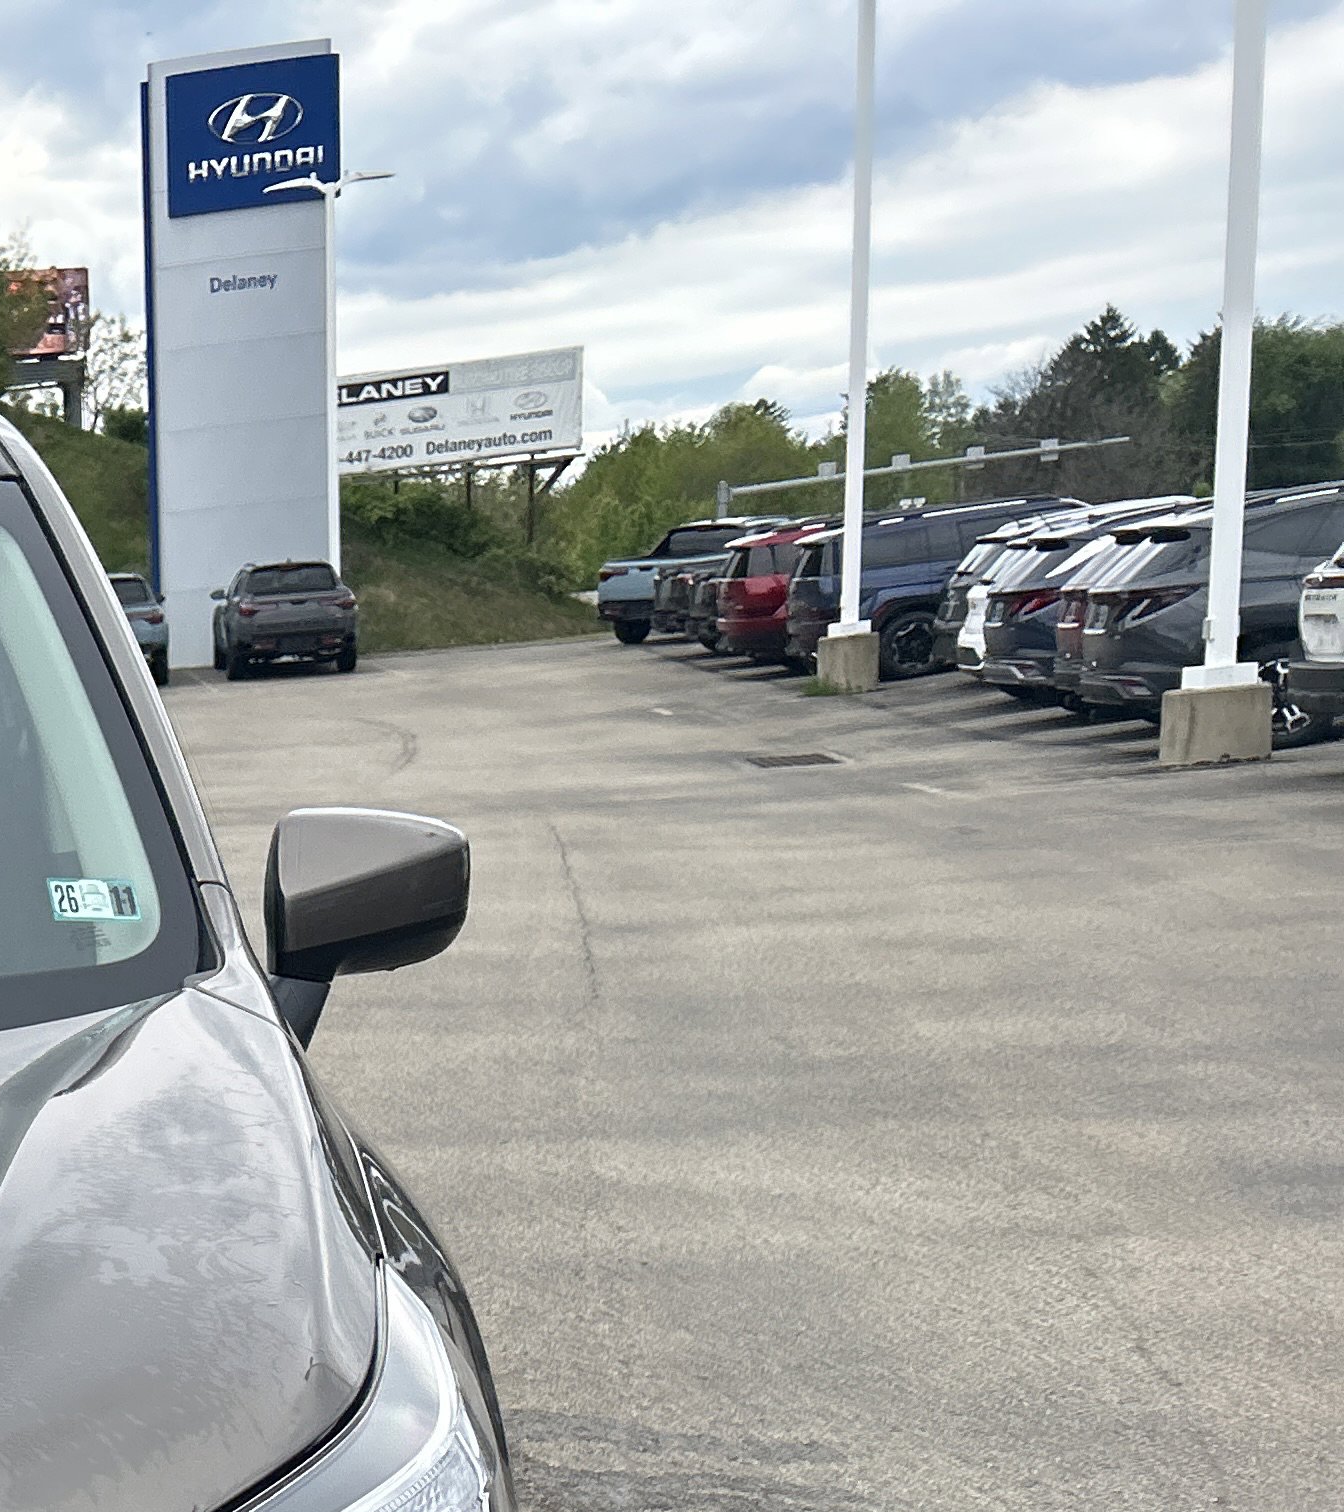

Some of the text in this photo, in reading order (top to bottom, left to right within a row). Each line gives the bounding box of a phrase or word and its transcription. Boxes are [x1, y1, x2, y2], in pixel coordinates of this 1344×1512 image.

[188, 145, 324, 183] HYUNDAI
[209, 274, 278, 294] Delaney
[337, 375, 444, 403] LANEY
[426, 430, 553, 455] Delaneyauto.com
[55, 884, 80, 914] 26
